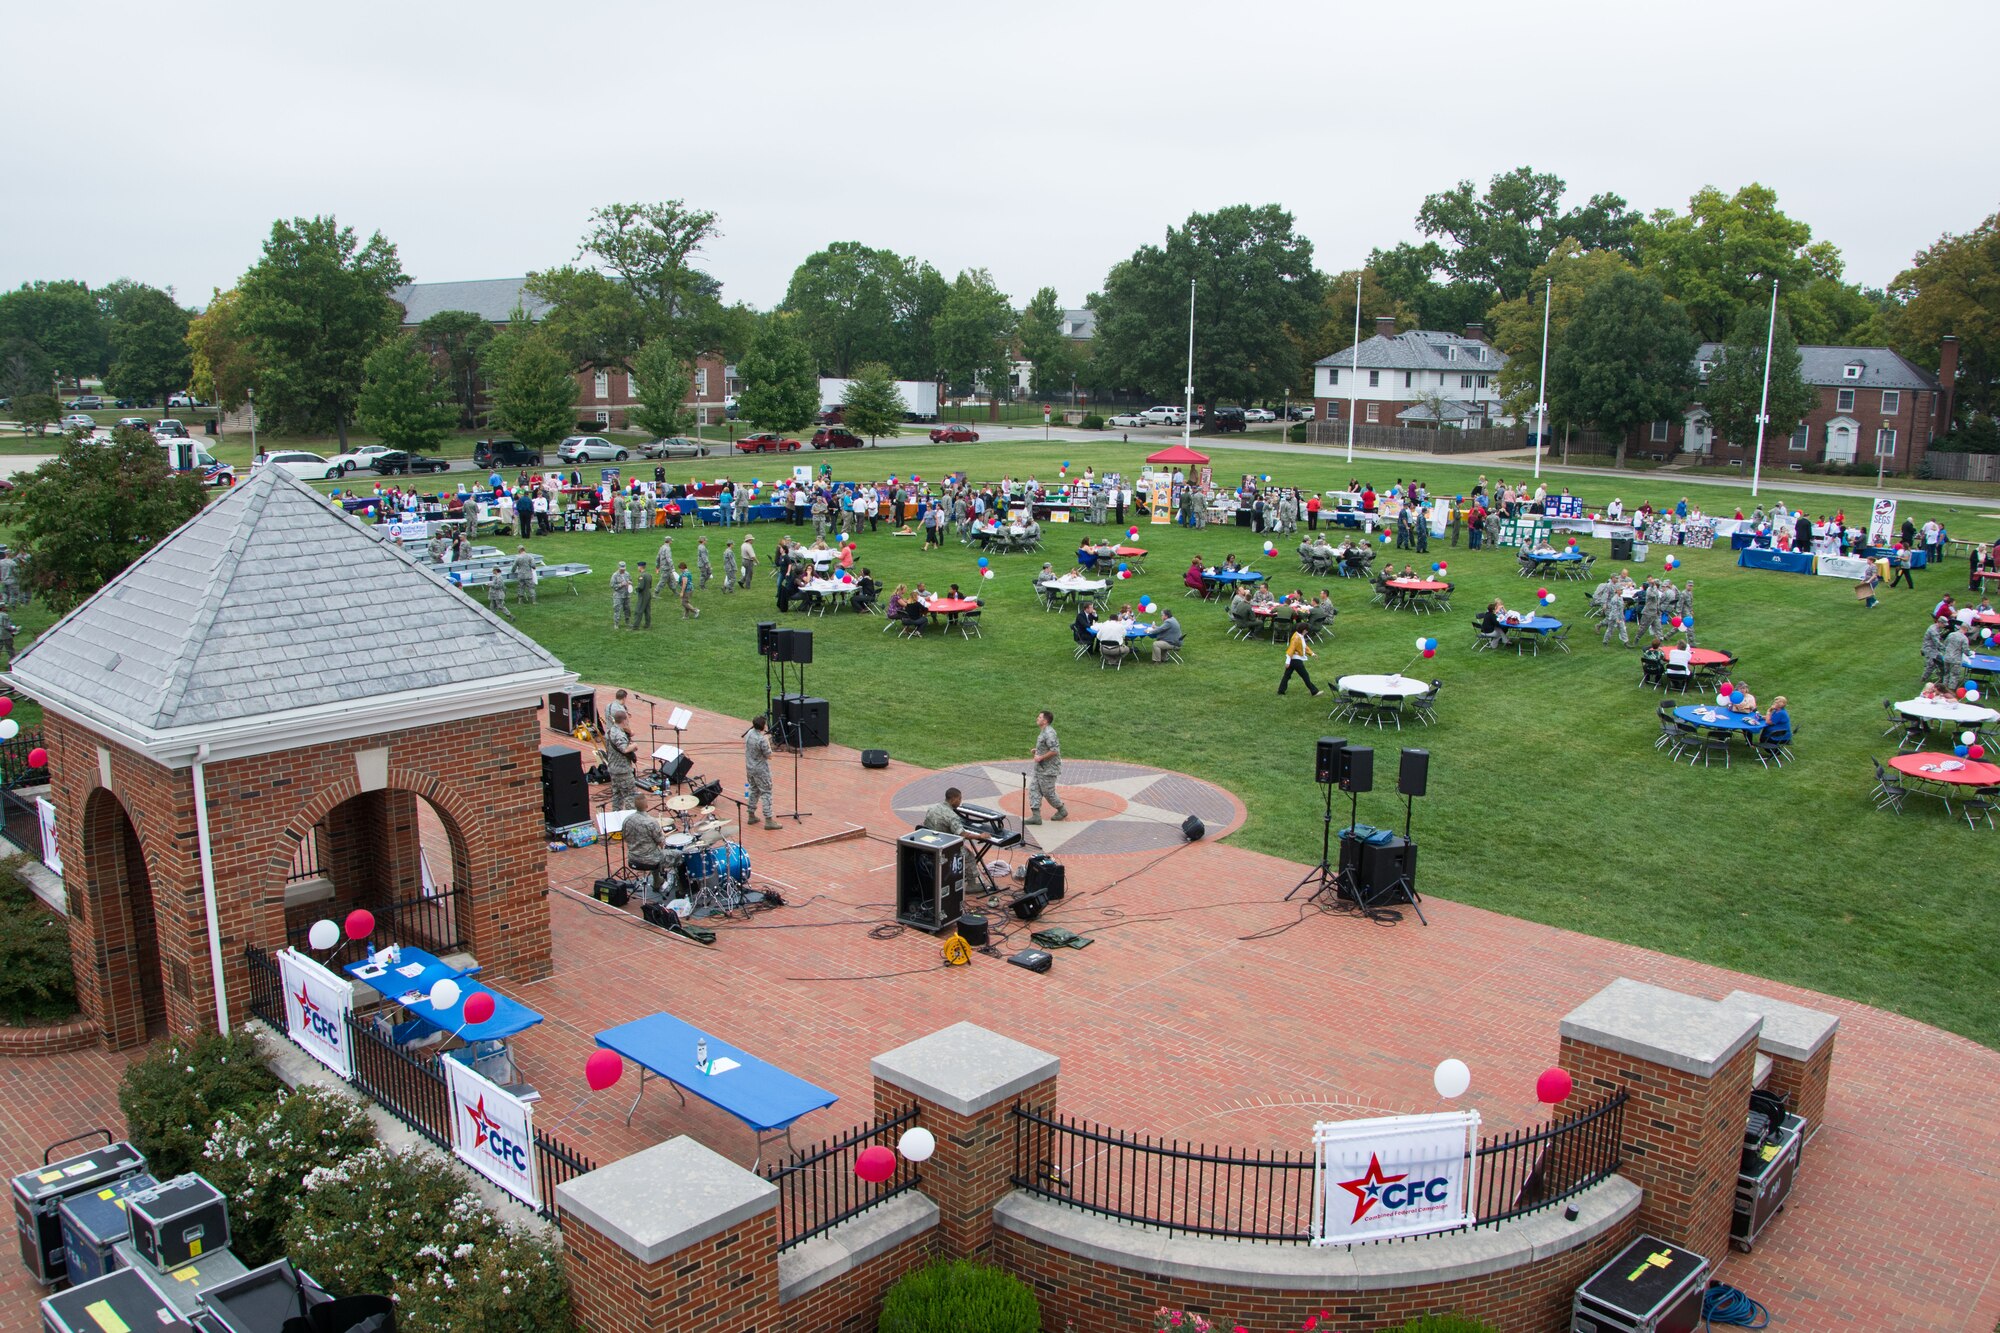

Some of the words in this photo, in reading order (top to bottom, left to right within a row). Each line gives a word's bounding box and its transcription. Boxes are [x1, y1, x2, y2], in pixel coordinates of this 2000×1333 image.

[1874, 515, 1891, 524] SEGS
[312, 1012, 338, 1044] CFC
[490, 1130, 526, 1171] CFC
[1382, 1177, 1449, 1209] CFC
[1364, 1210, 1394, 1222] Combined
[1394, 1207, 1418, 1216] Federal
[1418, 1203, 1448, 1213] Campaign
